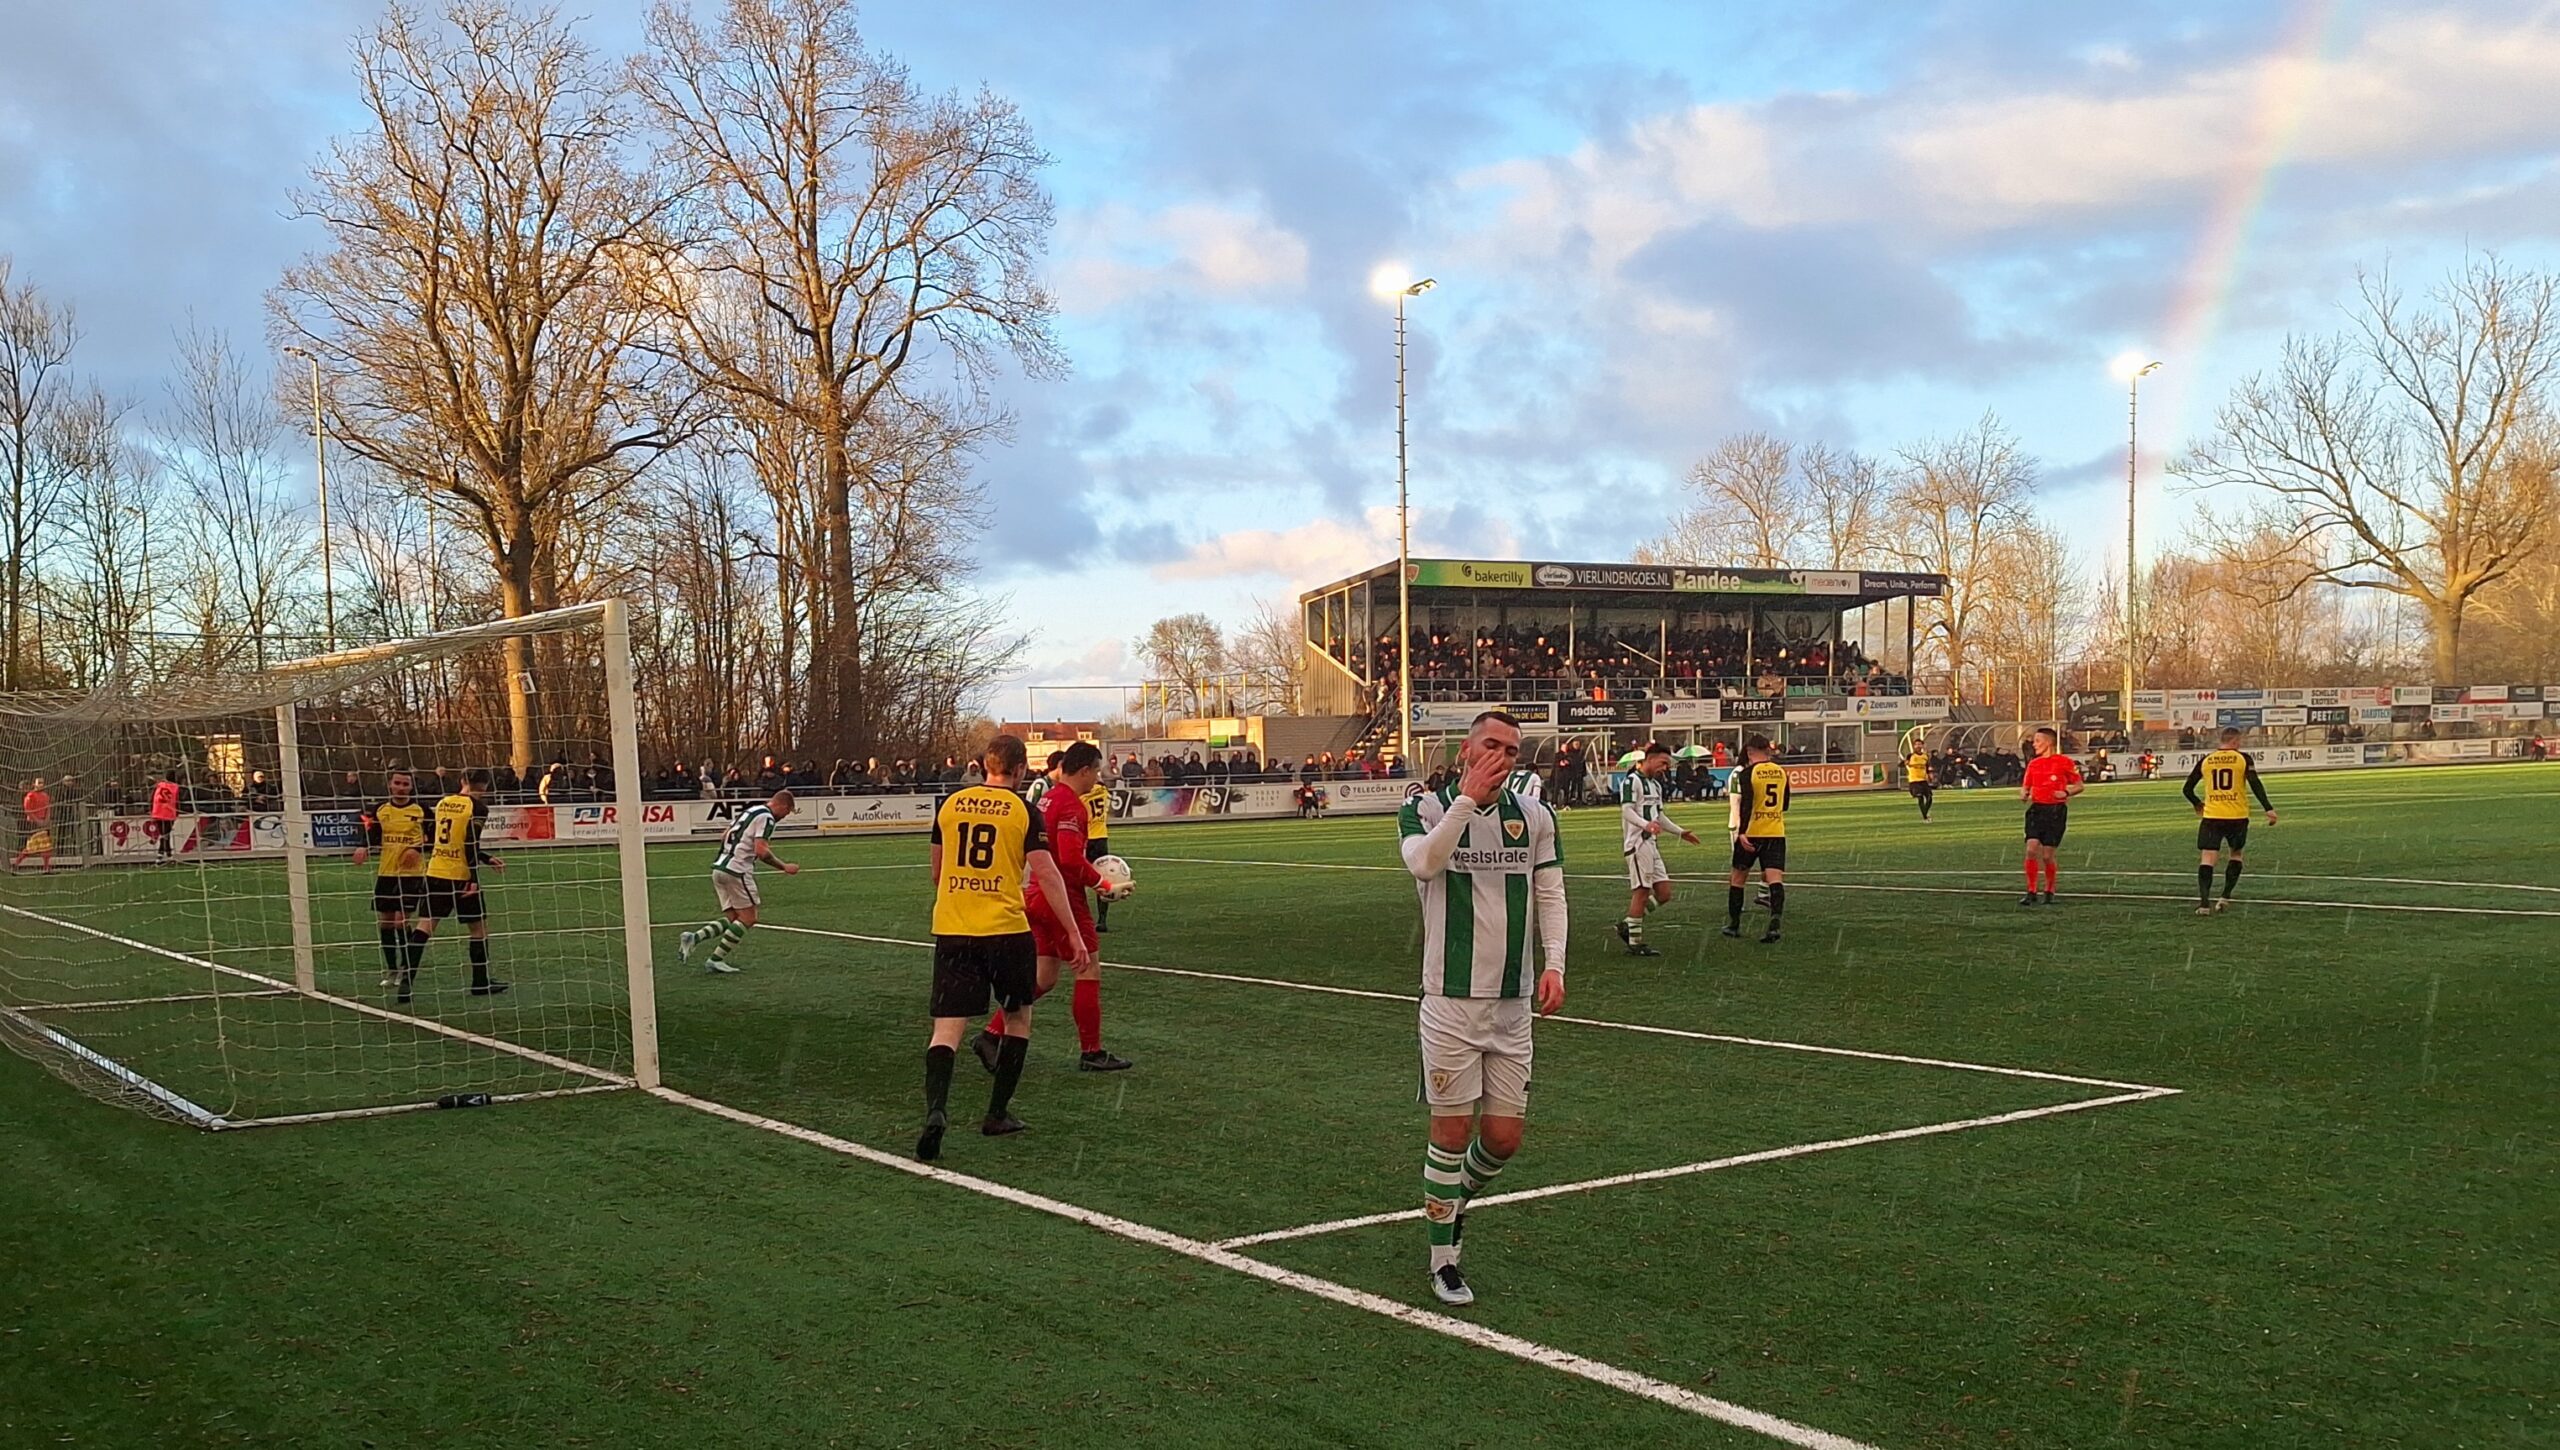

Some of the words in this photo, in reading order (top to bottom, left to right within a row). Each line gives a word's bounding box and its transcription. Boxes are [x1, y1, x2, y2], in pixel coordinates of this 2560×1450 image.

[1474, 571, 1524, 586] bakertilly
[1576, 570, 1670, 586] VIERLINDENGOES.NL
[1674, 569, 1741, 590] Zandee
[1864, 579, 1889, 589] Dream,
[1890, 580, 1910, 590] Unite,
[1911, 581, 1937, 590] Perform
[2311, 689, 2339, 697] SCHELDE
[1732, 701, 1773, 710] FABERY
[1870, 700, 1898, 709] Zeeuws
[1911, 697, 1946, 708] KATSMAN
[2290, 750, 2312, 760] TUMS
[1787, 767, 1857, 785] eststrate
[2211, 768, 2234, 790] 10
[1396, 785, 1403, 793] IT
[1764, 783, 1778, 807] 5
[955, 796, 1012, 810] KNOPS
[1089, 797, 1104, 818] 15
[601, 805, 675, 825] RSA
[852, 809, 902, 821] AutoKievit
[954, 806, 1010, 817] VASTGOED
[340, 814, 350, 824] &
[438, 817, 453, 844] 3
[643, 826, 675, 834] ntilatie
[957, 821, 997, 869] 18
[949, 875, 1003, 893] preuf
